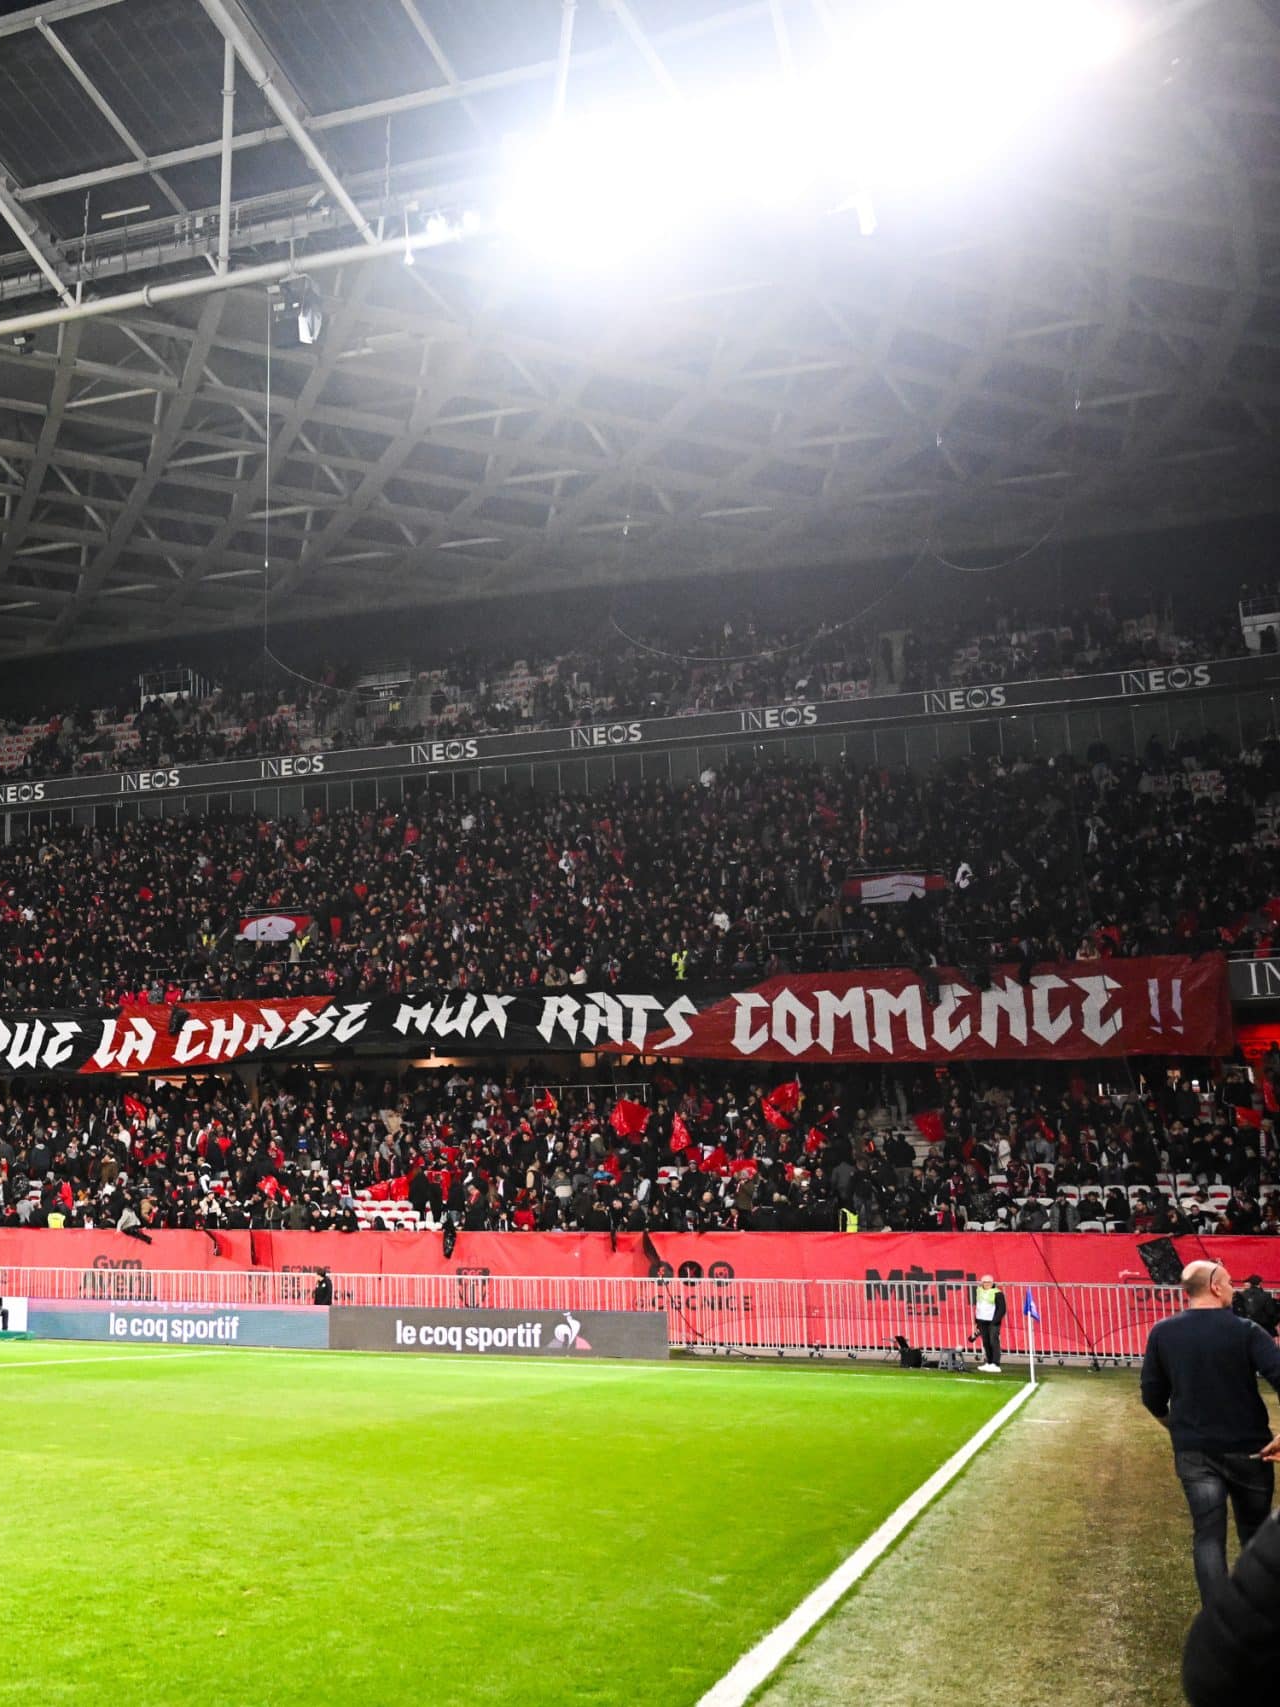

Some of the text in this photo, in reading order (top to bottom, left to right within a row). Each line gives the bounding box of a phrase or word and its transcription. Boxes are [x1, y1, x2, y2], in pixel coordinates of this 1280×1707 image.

[1120, 664, 1211, 693] INEOS
[923, 686, 1006, 713] INEOS
[739, 704, 818, 730] INEOS
[570, 722, 642, 746] INEOS
[410, 739, 479, 763] INEOS
[261, 755, 324, 777] INEOS
[120, 769, 180, 791] INEOS
[91, 1017, 157, 1069] LA
[171, 1001, 372, 1065] CHASSE
[392, 991, 518, 1039] AUX
[535, 991, 700, 1054] RATS
[730, 974, 1123, 1056] COMMENCE
[109, 1312, 239, 1343] le coq sportif
[396, 1320, 542, 1352] le coq sportif
